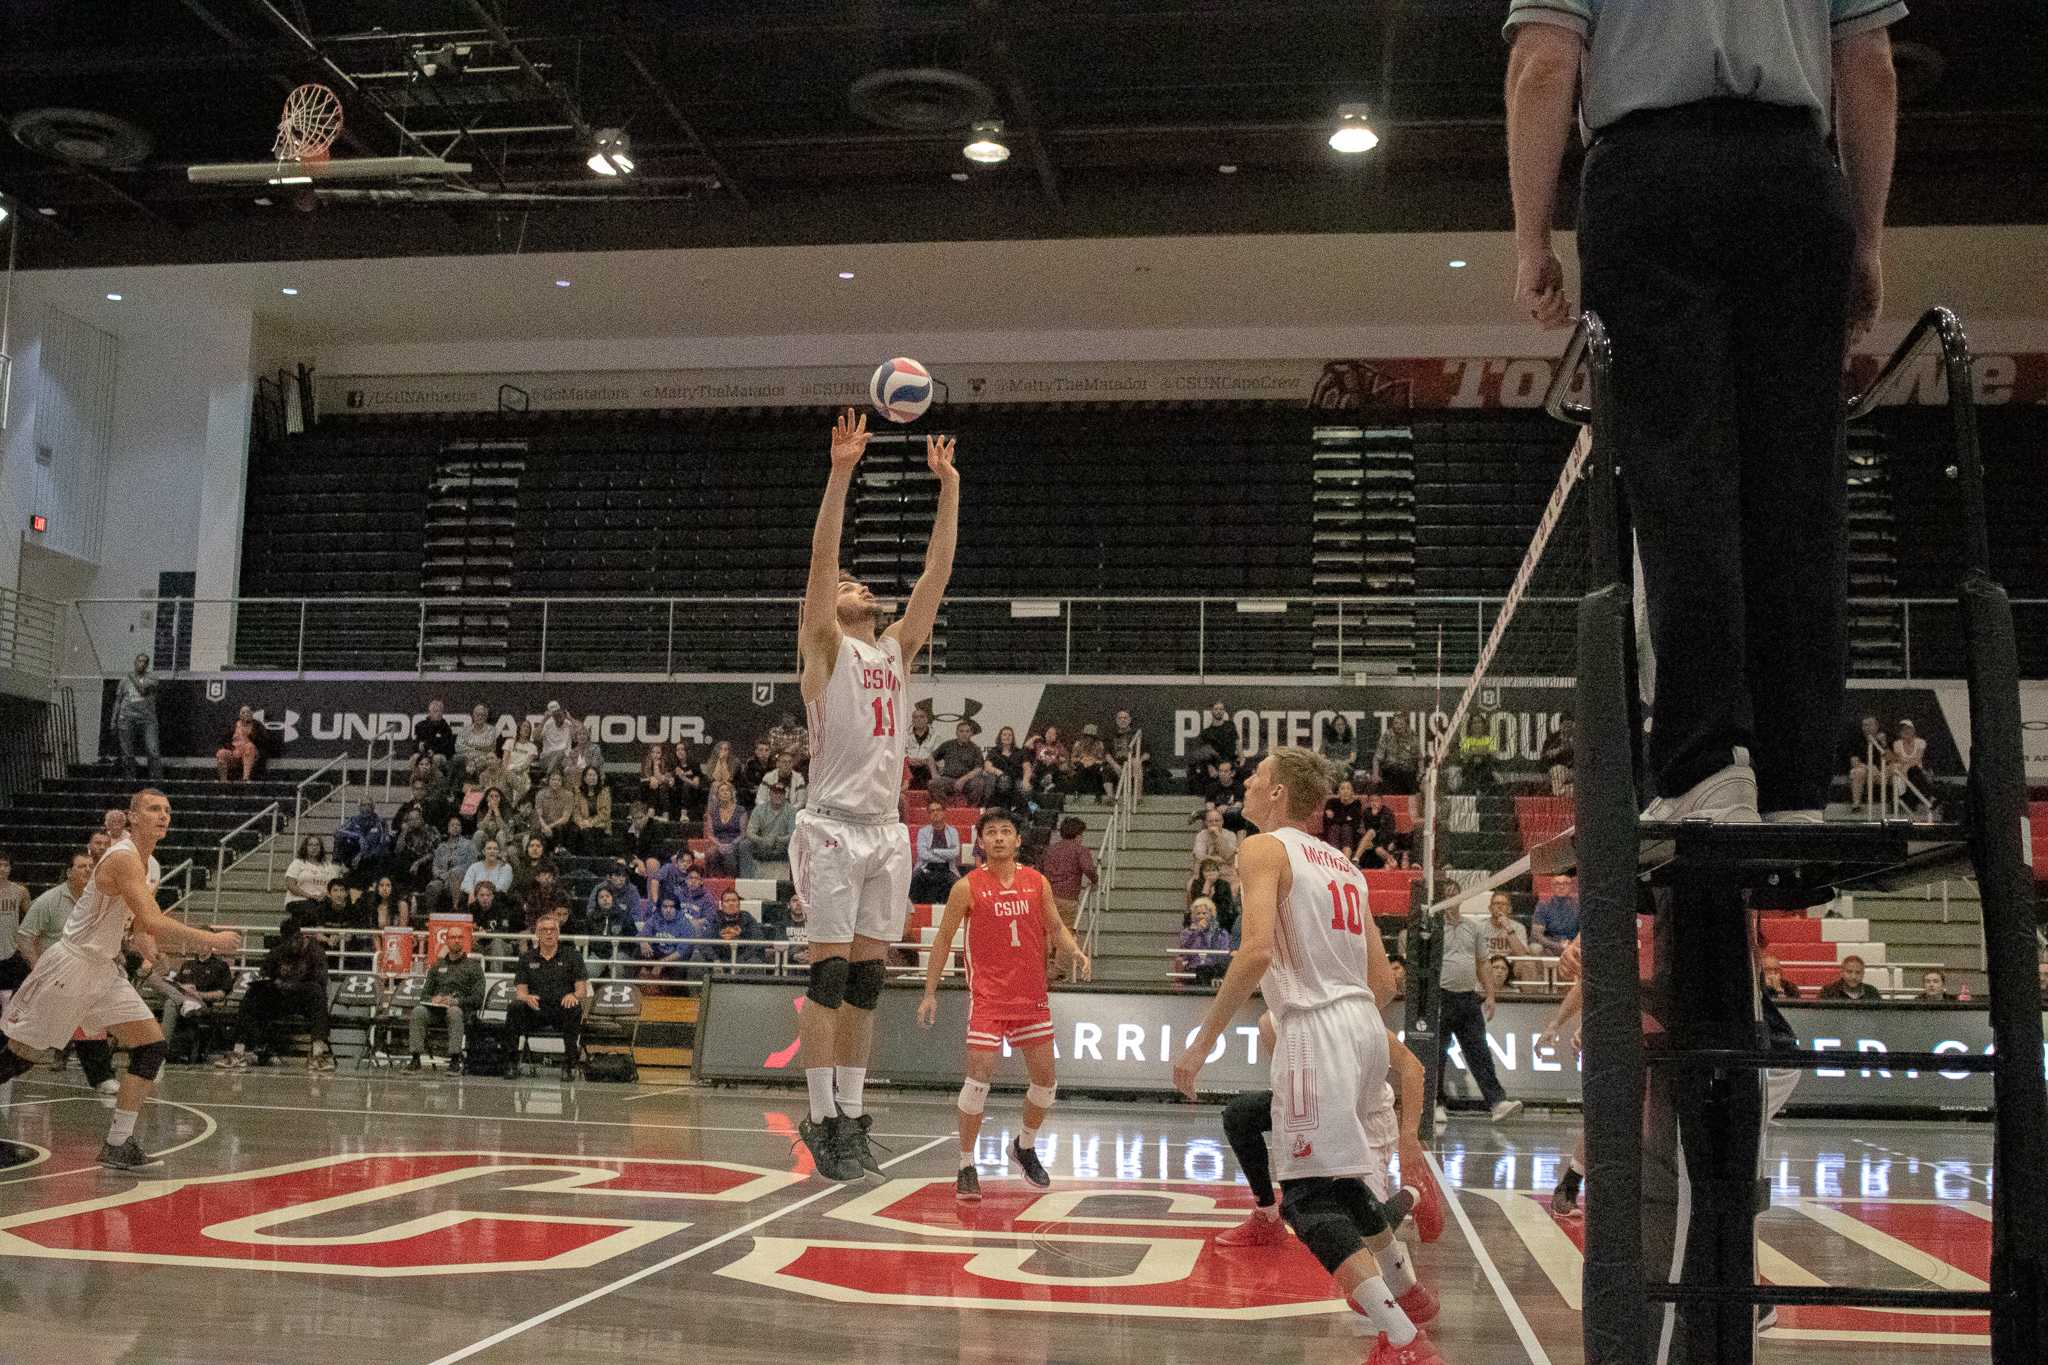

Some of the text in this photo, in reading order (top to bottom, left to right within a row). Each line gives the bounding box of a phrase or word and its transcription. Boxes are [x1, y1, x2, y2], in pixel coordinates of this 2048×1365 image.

[758, 686, 769, 700] 7
[871, 696, 894, 736] 11
[994, 900, 1030, 917] CSUN
[1327, 880, 1363, 936] 10
[1008, 919, 1021, 948] 1
